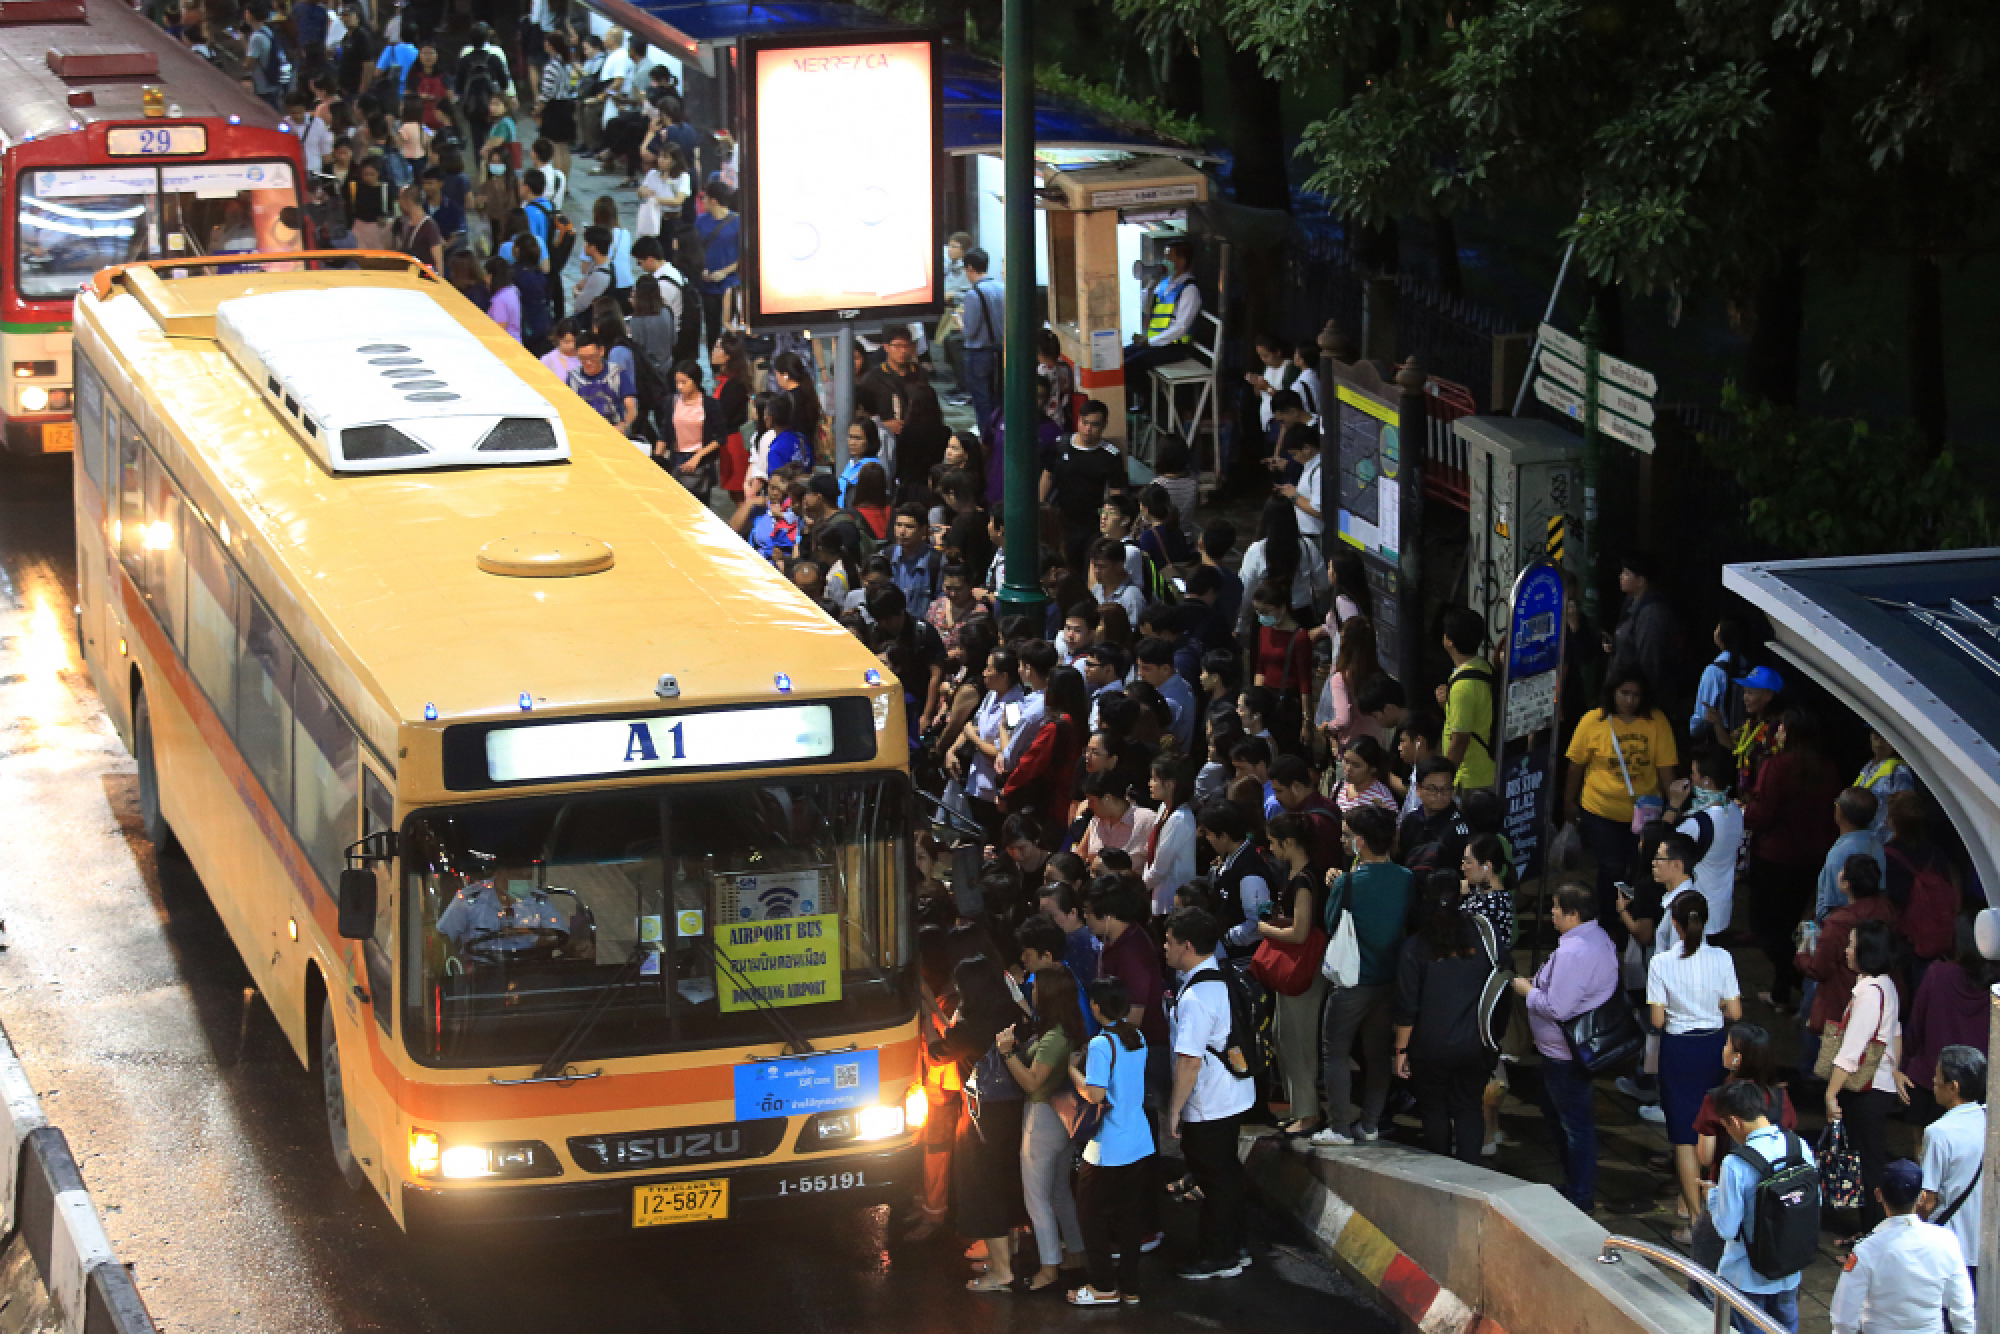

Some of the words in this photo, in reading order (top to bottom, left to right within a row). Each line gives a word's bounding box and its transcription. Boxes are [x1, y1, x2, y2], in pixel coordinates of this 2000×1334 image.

[140, 129, 171, 153] 29
[1521, 770, 1543, 793] STOP
[729, 923, 793, 946] AIRPORT
[795, 919, 823, 939] BUS
[787, 979, 827, 999] AIRPORT
[618, 1129, 739, 1163] ISUZU
[778, 1170, 866, 1196] 1-55191
[643, 1189, 722, 1214] 12-5877
